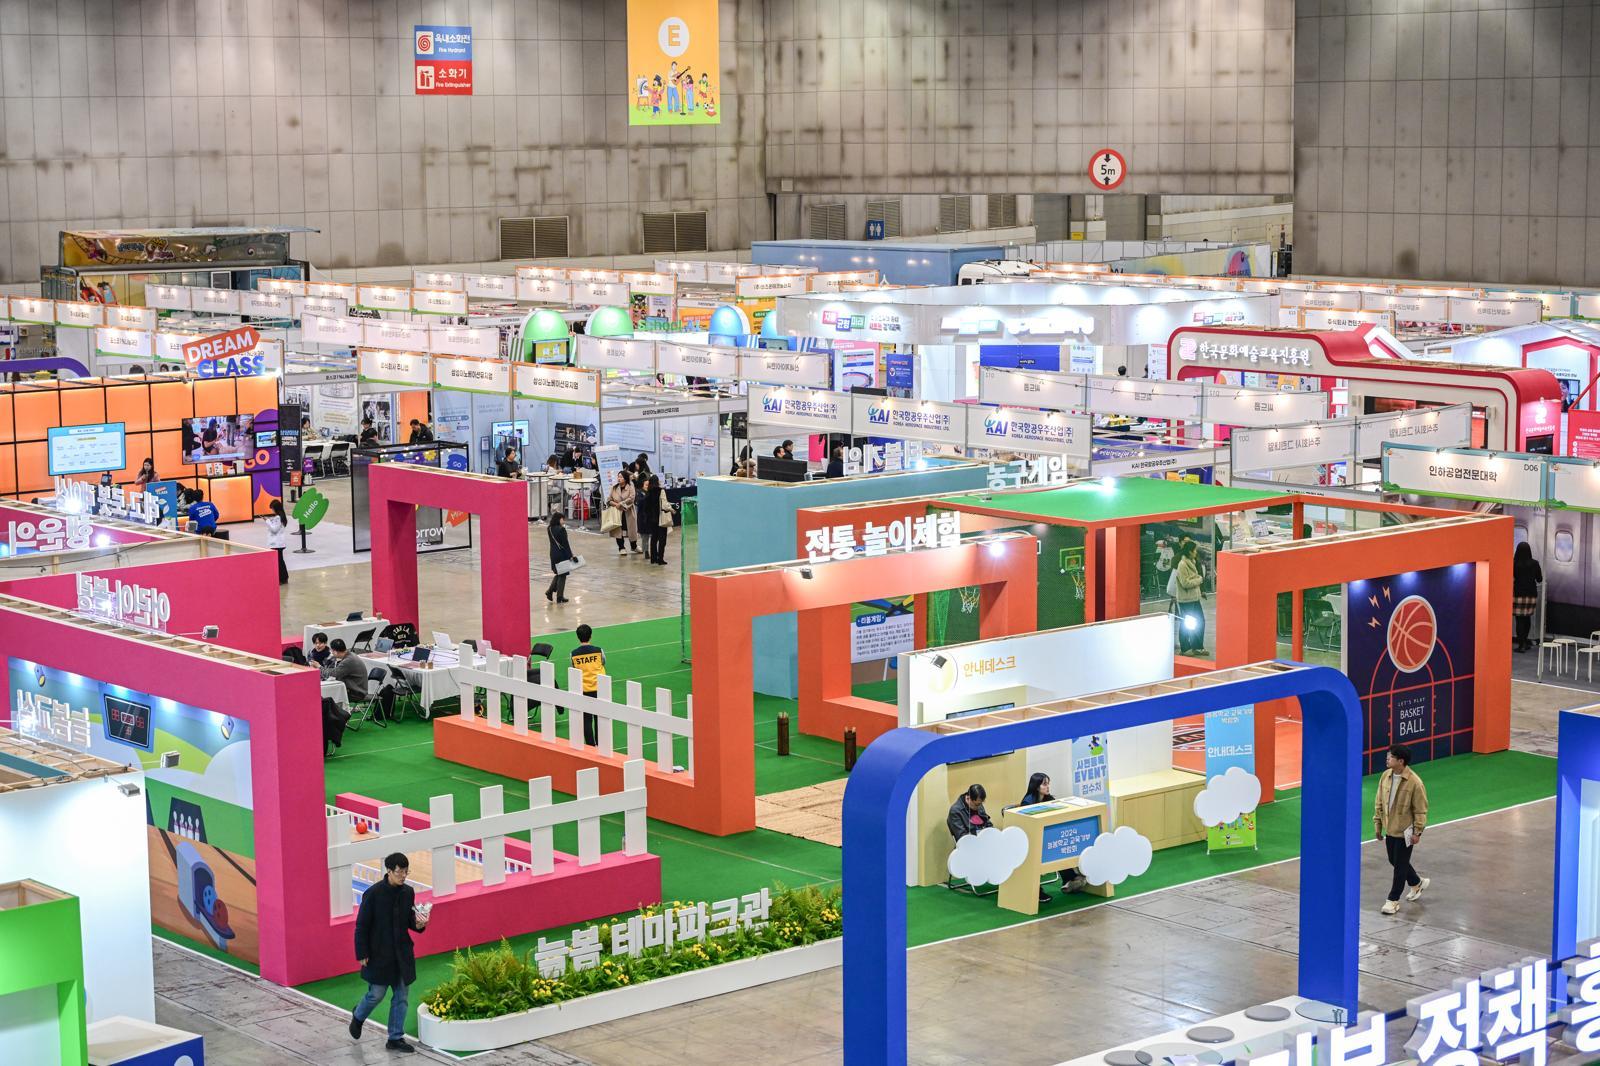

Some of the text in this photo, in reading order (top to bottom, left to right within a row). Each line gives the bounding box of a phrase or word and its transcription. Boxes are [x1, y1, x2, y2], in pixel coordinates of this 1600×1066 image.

[435, 33, 470, 43] 옥내소화전
[668, 25, 681, 46] E
[1100, 164, 1116, 176] 5m
[837, 319, 850, 329] 균형
[187, 331, 254, 363] DREAM
[1199, 341, 1311, 366] 한국문화예술교육진흥원
[197, 356, 265, 378] CLASS
[533, 377, 579, 390] 삼성이노베이션뮤지엄
[763, 393, 837, 414] KAI 한국항공우주산업(주)
[868, 405, 951, 426] KAI 한국항공우주산업(주)
[984, 416, 1073, 438] KAI 한국항공우주산업(주)
[987, 454, 1068, 492] 농구게임
[1429, 465, 1498, 482] 인하공업전문대학
[1524, 464, 1538, 472] D06
[303, 499, 319, 519] Hello
[416, 527, 447, 539] orrow
[805, 511, 962, 564] 전통 놀이체험
[575, 655, 598, 665] STAFF
[963, 655, 1017, 678] 안내데스크
[1400, 706, 1425, 720] BASKET
[1399, 718, 1425, 736] BALL
[1208, 744, 1253, 758] 안내데스크
[1074, 765, 1107, 784] EVENT
[1082, 782, 1102, 795] 접수처
[1060, 828, 1078, 838] 2024
[534, 887, 773, 979] 늘봄 테마파크관
[1410, 958, 1548, 1066] 정책
